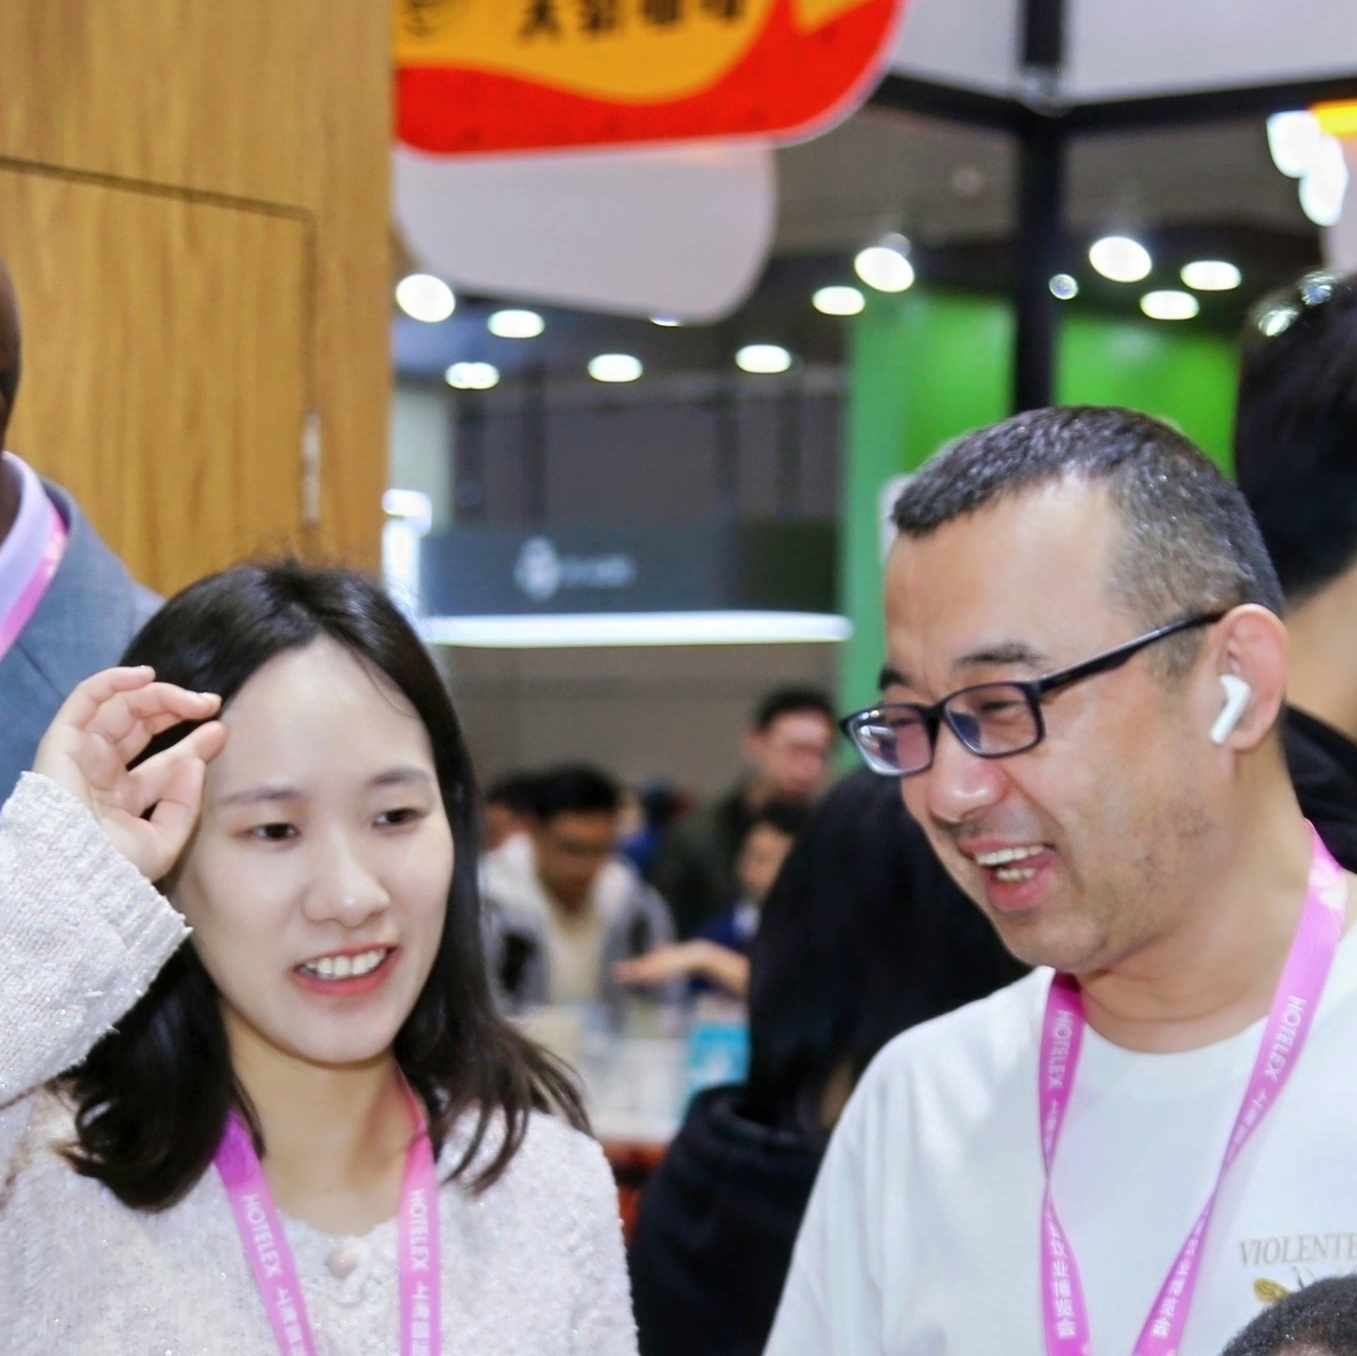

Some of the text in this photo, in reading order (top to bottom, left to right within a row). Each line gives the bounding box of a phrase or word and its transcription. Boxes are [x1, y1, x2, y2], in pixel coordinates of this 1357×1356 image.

[1047, 1008, 1075, 1089] HOTELEX
[1263, 994, 1307, 1083] HOTELEX
[241, 1193, 284, 1279] HOTELEX
[408, 1188, 430, 1272] HOTELEX
